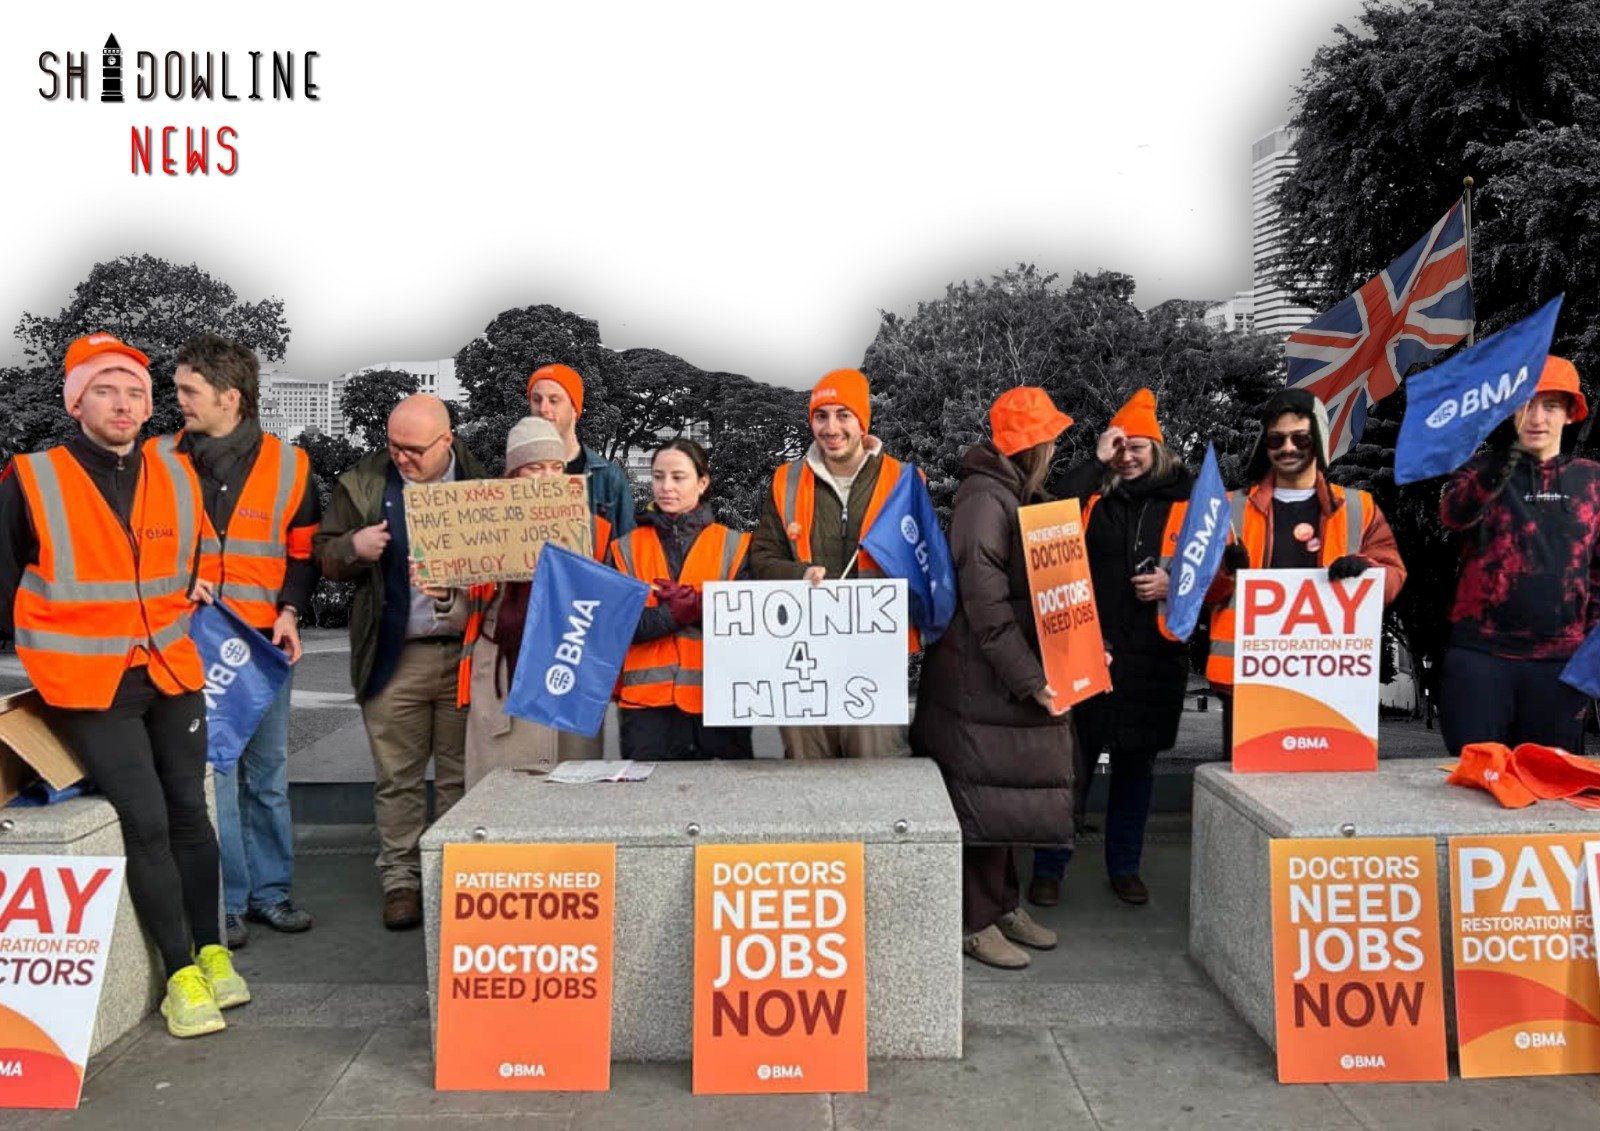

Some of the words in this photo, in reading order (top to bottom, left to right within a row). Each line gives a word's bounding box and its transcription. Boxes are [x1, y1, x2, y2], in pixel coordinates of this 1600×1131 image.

[1461, 365, 1529, 418] BMA
[409, 490, 457, 509] EVEN
[464, 486, 505, 503] XMAS
[510, 481, 563, 500] ELVES
[413, 511, 453, 530] HAVE
[457, 507, 500, 524] MORE
[502, 506, 525, 522] JOB
[530, 505, 585, 520] SECURITY
[1183, 497, 1221, 567] BMA
[420, 534, 452, 550] WE
[460, 529, 510, 546] WANT
[1031, 537, 1083, 571] DOCTORS
[430, 554, 505, 578] EMPLOY
[523, 552, 537, 570] U
[713, 585, 898, 639] HONK
[1037, 578, 1090, 615] DOCTORS
[1243, 578, 1376, 635] PAY
[555, 600, 601, 667] BMA
[1042, 612, 1071, 637] NEED
[1072, 603, 1095, 630] JOBS
[785, 640, 818, 680] 4
[1242, 638, 1341, 652] RESTORATION
[1345, 638, 1373, 651] FOR
[1241, 654, 1372, 677] DOCTORS
[203, 664, 237, 710] BM
[732, 675, 879, 719] NHS
[1298, 736, 1328, 749] BMA
[455, 873, 544, 888] PATIENTS
[549, 873, 600, 887] NEED
[713, 861, 847, 885] DOCTORS
[1289, 856, 1420, 879] DOCTORS
[1458, 846, 1587, 913] PAY
[0, 867, 112, 934] AY
[455, 892, 599, 920] DOCTORS
[713, 889, 847, 929] NEED
[1290, 883, 1421, 923] NEED
[1461, 914, 1571, 931] RESTORATION
[1575, 914, 1593, 929] FO
[66, 940, 99, 954] FOR
[453, 945, 597, 973] DOCTORS
[713, 933, 847, 988] JOBS
[1293, 927, 1424, 980] JOBS
[452, 977, 526, 999] NEED
[531, 977, 597, 1002] JOBS
[1294, 982, 1424, 1027] NOW
[712, 989, 847, 1036] NOW
[1531, 1032, 1566, 1047] BMA
[513, 1065, 545, 1076] BMA
[772, 1065, 803, 1078] BMA
[1355, 1055, 1386, 1068] BMA
